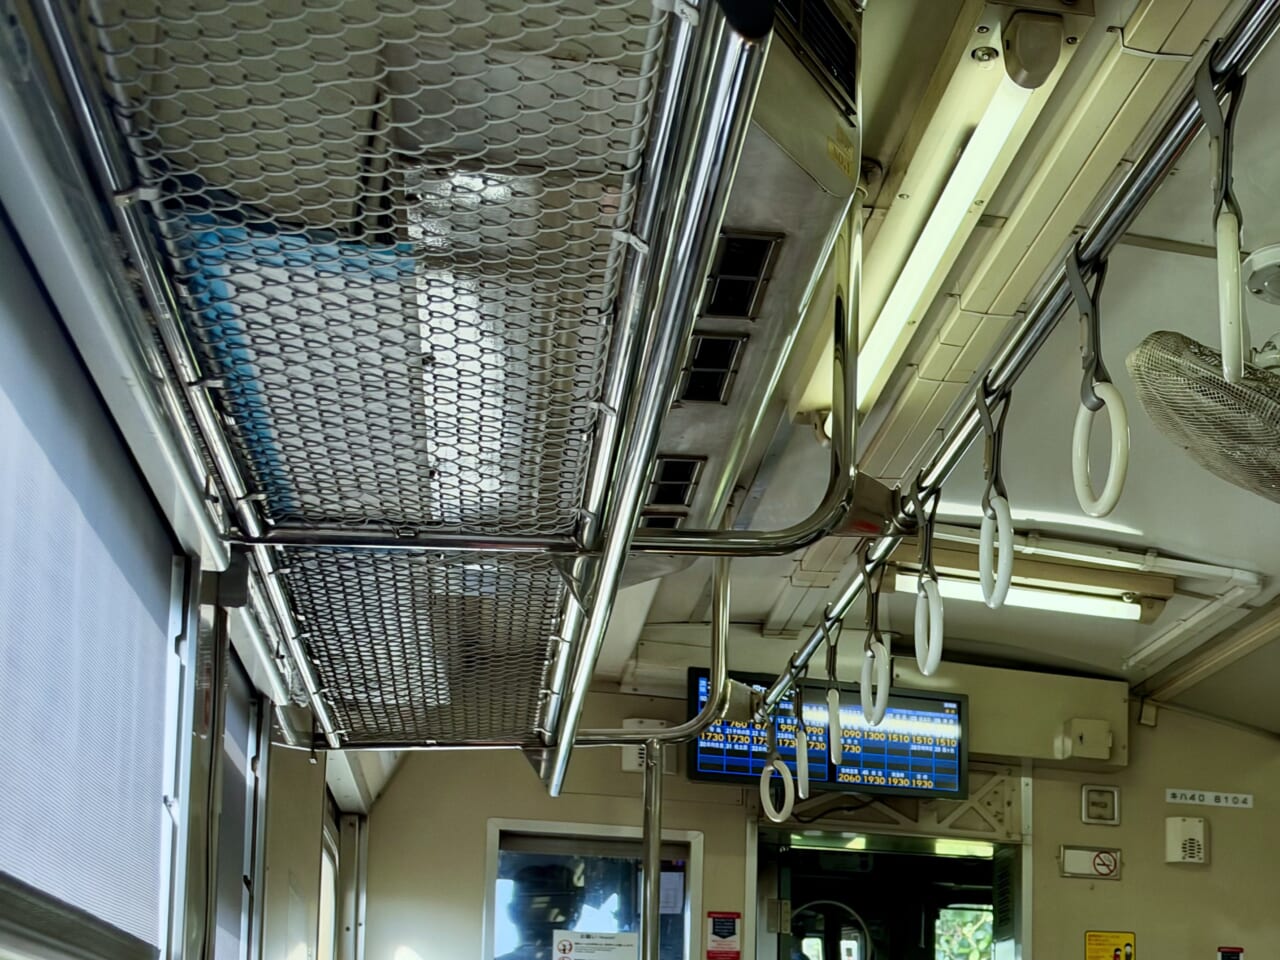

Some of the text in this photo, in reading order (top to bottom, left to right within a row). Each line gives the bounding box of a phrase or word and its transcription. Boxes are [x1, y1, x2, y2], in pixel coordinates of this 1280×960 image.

[701, 732, 724, 741] 1730
[727, 734, 750, 743] 1730
[805, 726, 824, 735] 990
[863, 731, 886, 741] 1300
[887, 733, 910, 743] 1510
[911, 735, 934, 745] 1510
[935, 738, 957, 747] 1510
[837, 773, 862, 782] 2060
[863, 775, 886, 784] 1930
[887, 777, 910, 786] 1930
[911, 779, 934, 788] 1930
[1214, 795, 1249, 805] 8104
